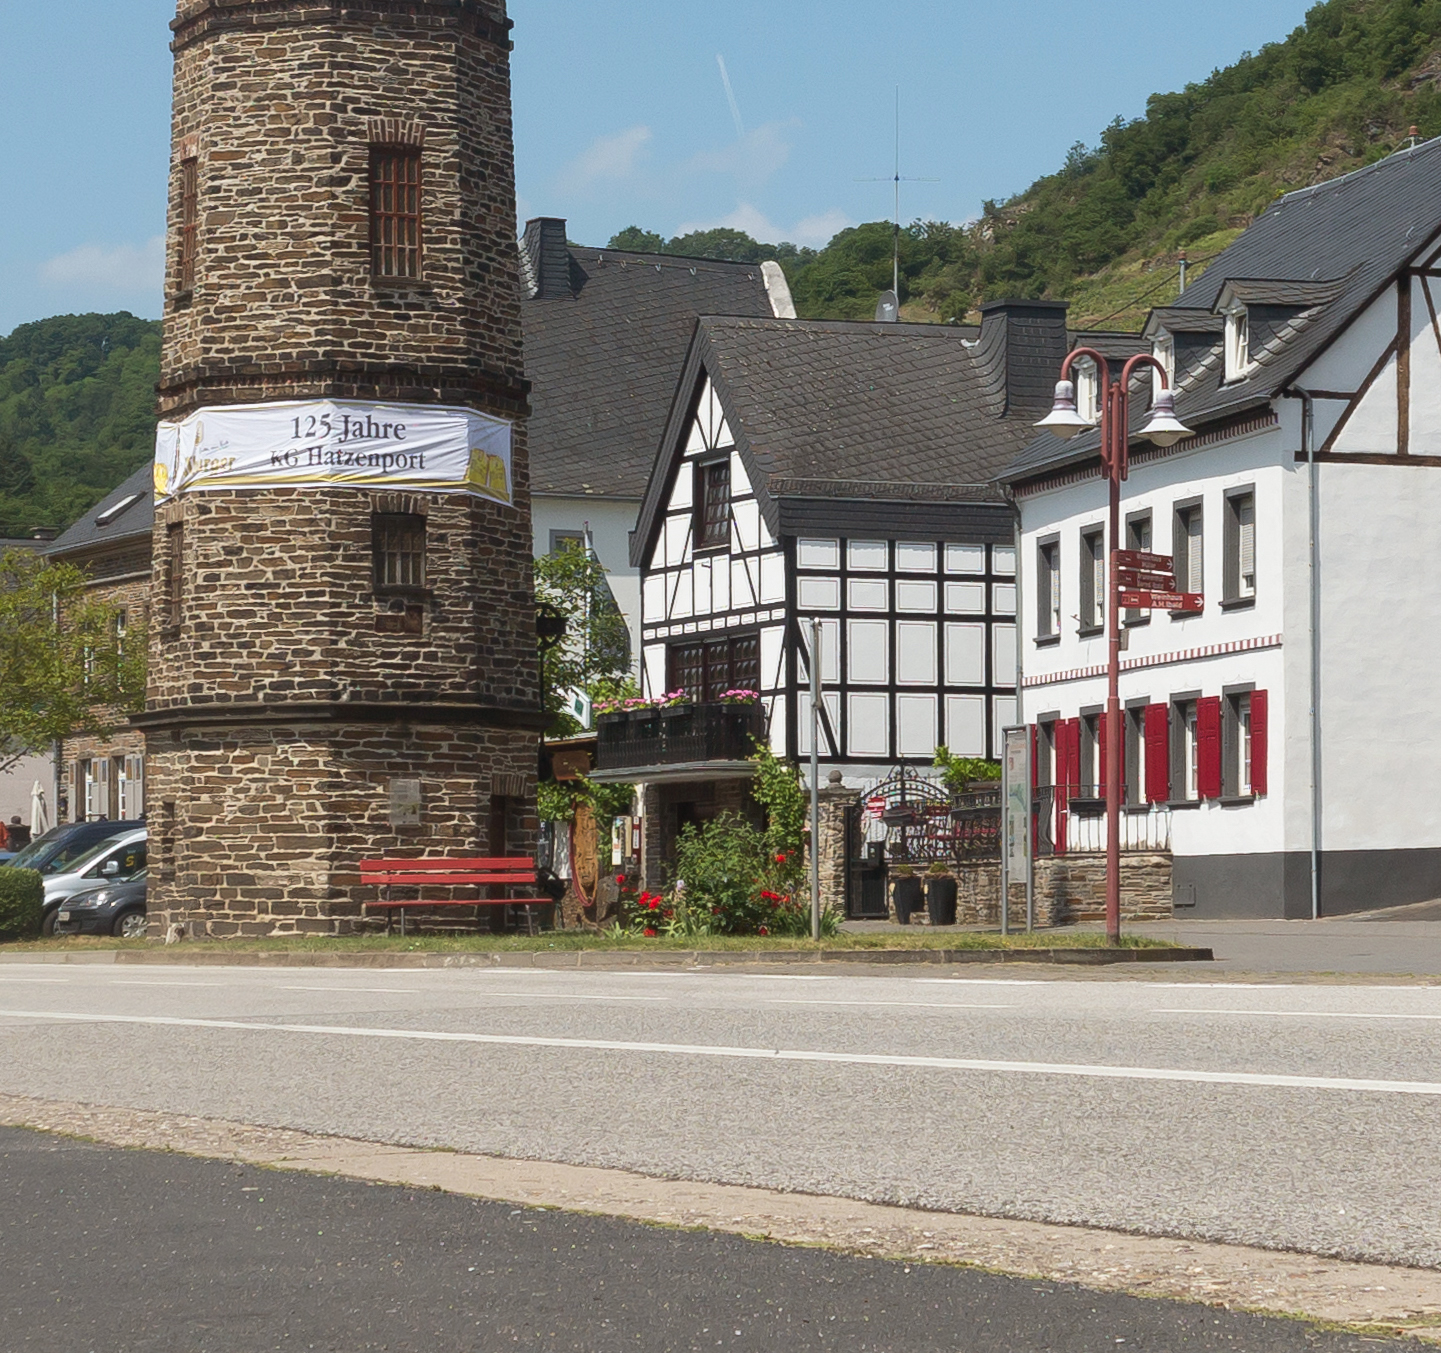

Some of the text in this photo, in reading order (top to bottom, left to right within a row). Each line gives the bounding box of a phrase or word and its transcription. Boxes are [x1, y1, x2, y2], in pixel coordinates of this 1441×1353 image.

[291, 413, 407, 443] 125 Jahre
[307, 446, 426, 473] Hatzenport
